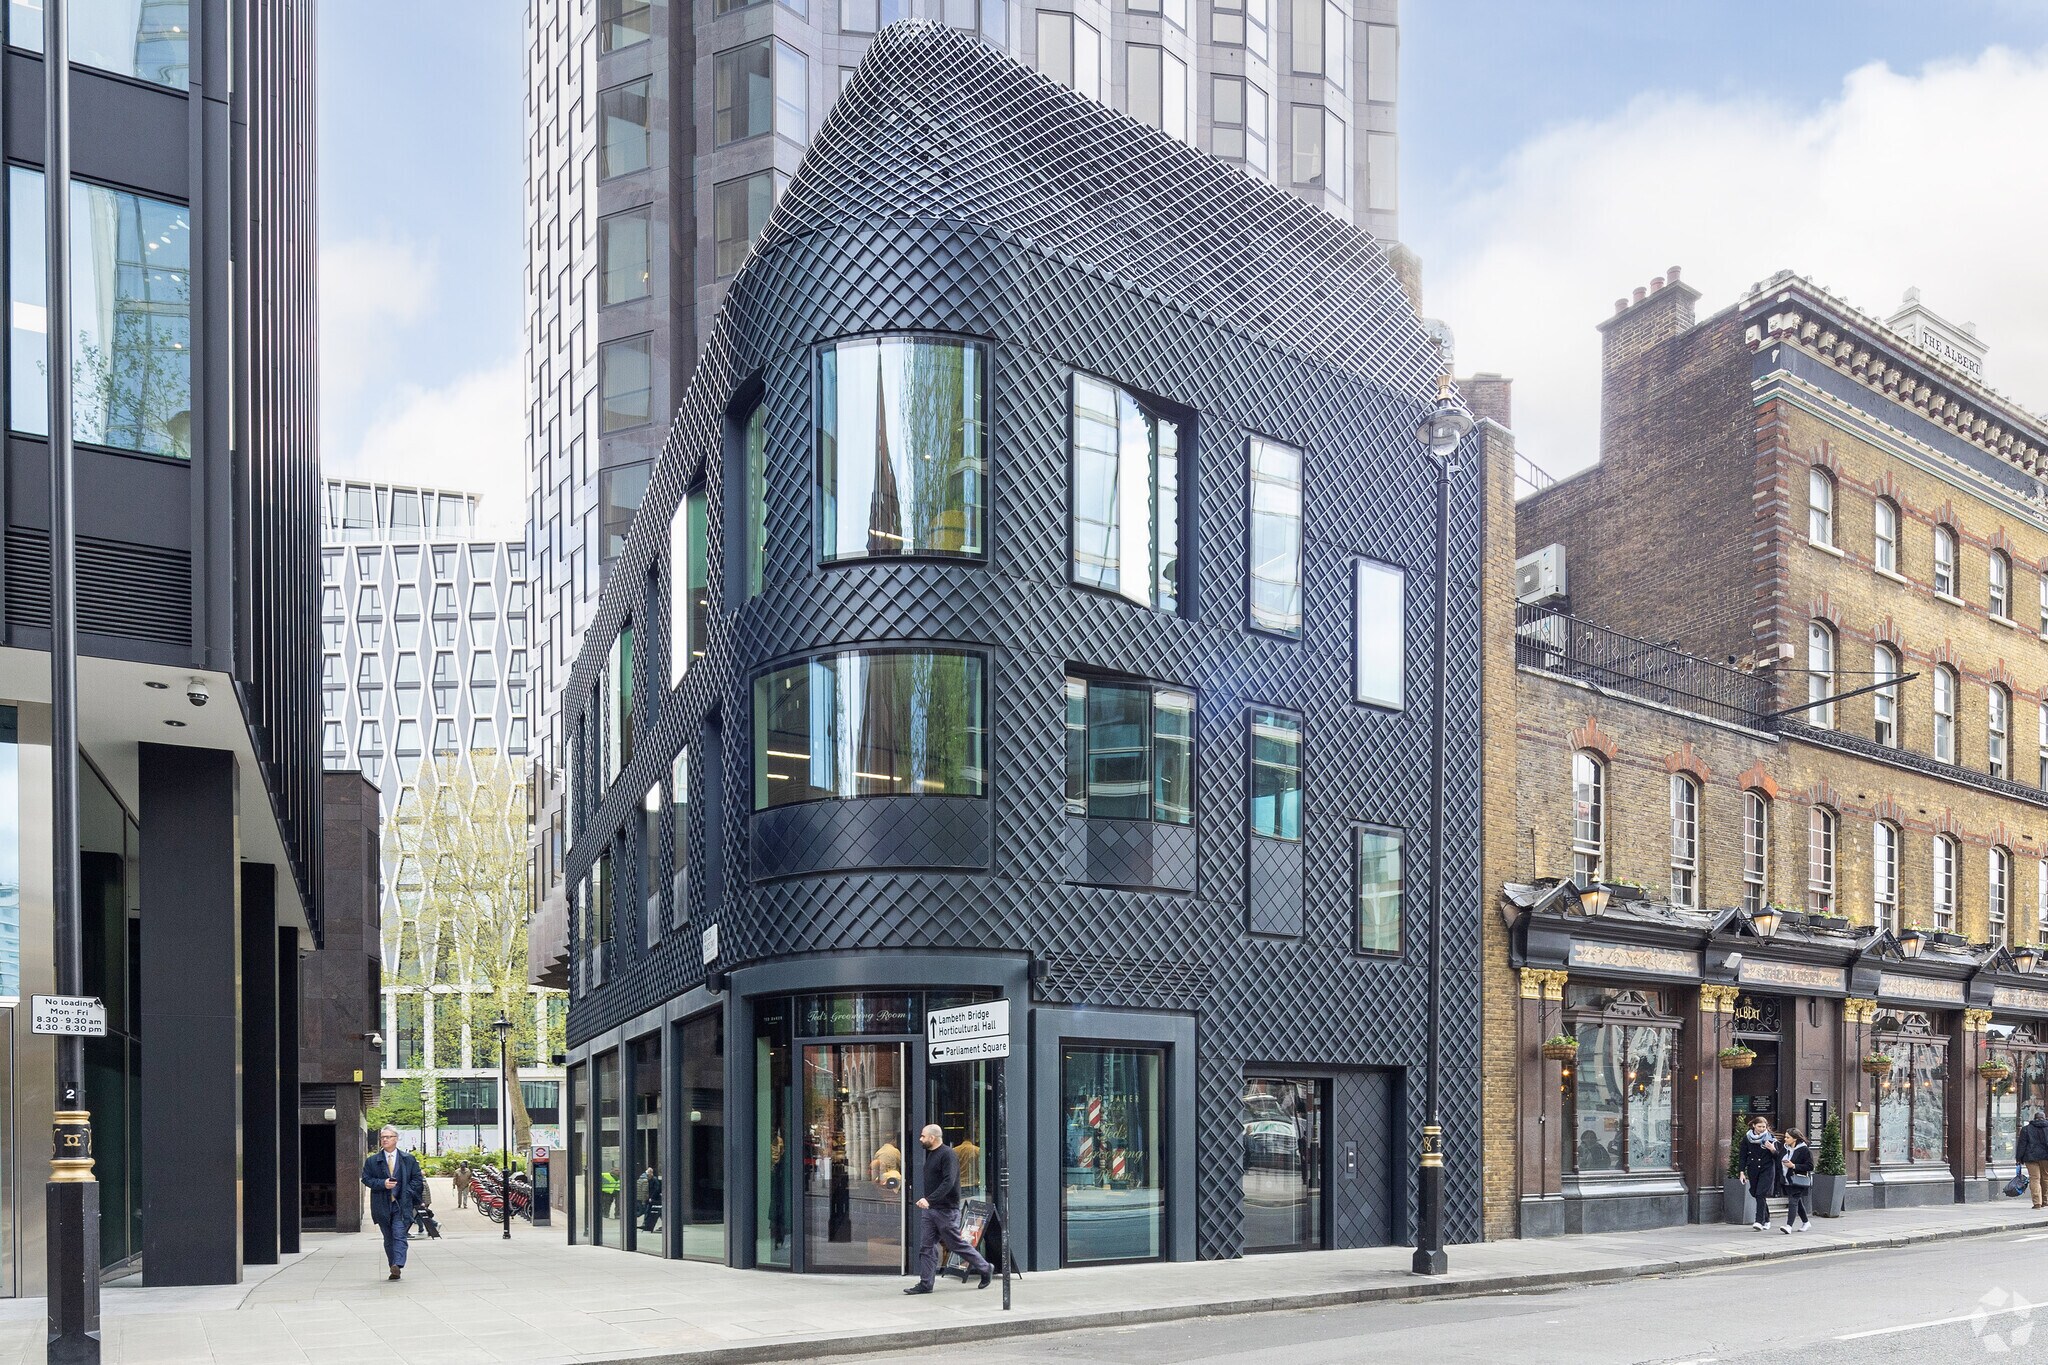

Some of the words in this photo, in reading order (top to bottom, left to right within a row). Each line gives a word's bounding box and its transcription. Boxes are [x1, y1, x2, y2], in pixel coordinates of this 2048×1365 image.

[1923, 332, 1942, 353] THE
[1944, 346, 1981, 375] ALBERT
[61, 999, 93, 1008] loading
[807, 1010, 828, 1022] Ted's
[830, 1011, 873, 1023] Grooming
[876, 1009, 906, 1021] Room
[938, 1012, 966, 1024] Lambeth
[967, 1010, 990, 1021] Bridge
[1735, 1005, 1760, 1020] ALBERT
[35, 1023, 58, 1031] 4.30
[938, 1025, 980, 1036] Horticultural
[982, 1020, 996, 1031] Hall
[945, 1045, 980, 1056] Parliament
[982, 1042, 1007, 1053] Square
[66, 1089, 75, 1099] 2
[1110, 1094, 1139, 1103] BAKER
[1098, 1121, 1127, 1140] Ted's
